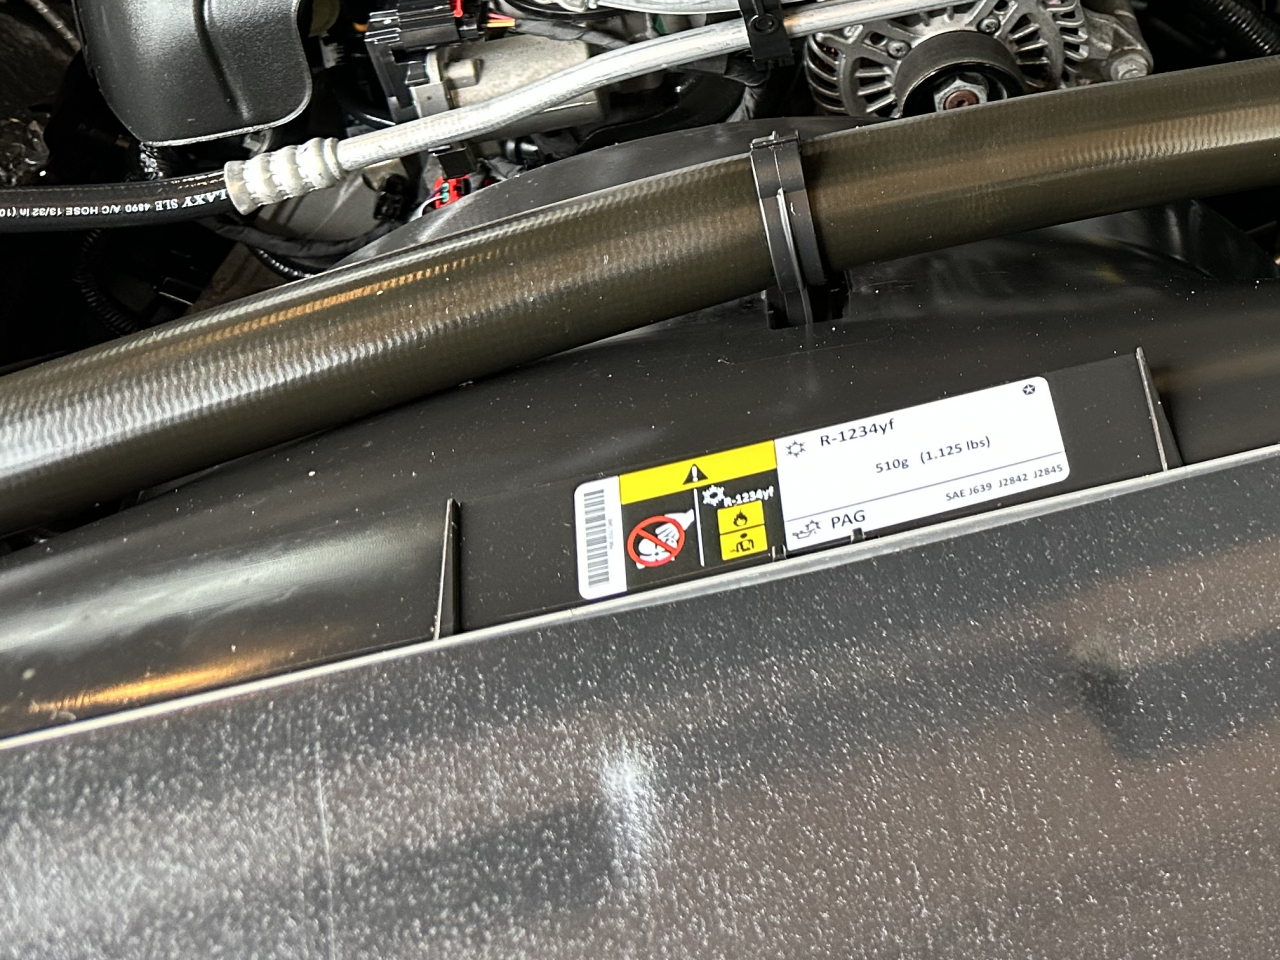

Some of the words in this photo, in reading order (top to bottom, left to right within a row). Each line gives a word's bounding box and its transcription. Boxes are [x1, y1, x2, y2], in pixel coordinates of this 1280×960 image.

[154, 198, 179, 212] SLE
[182, 189, 227, 208] LAXY
[33, 206, 62, 218] 13/32
[66, 206, 98, 217] HOSE
[101, 205, 121, 215] A/C
[125, 203, 151, 214] 4890
[819, 417, 895, 448] R-1234yf
[875, 457, 910, 475] 510g
[919, 443, 963, 465] (1.125
[966, 435, 992, 452] lbs)
[945, 490, 967, 502] SAE
[968, 482, 993, 497] J639
[998, 473, 1029, 489] J2842
[1033, 463, 1064, 480] J2845
[724, 486, 774, 507] R-1234yf
[830, 509, 867, 530] PAG
